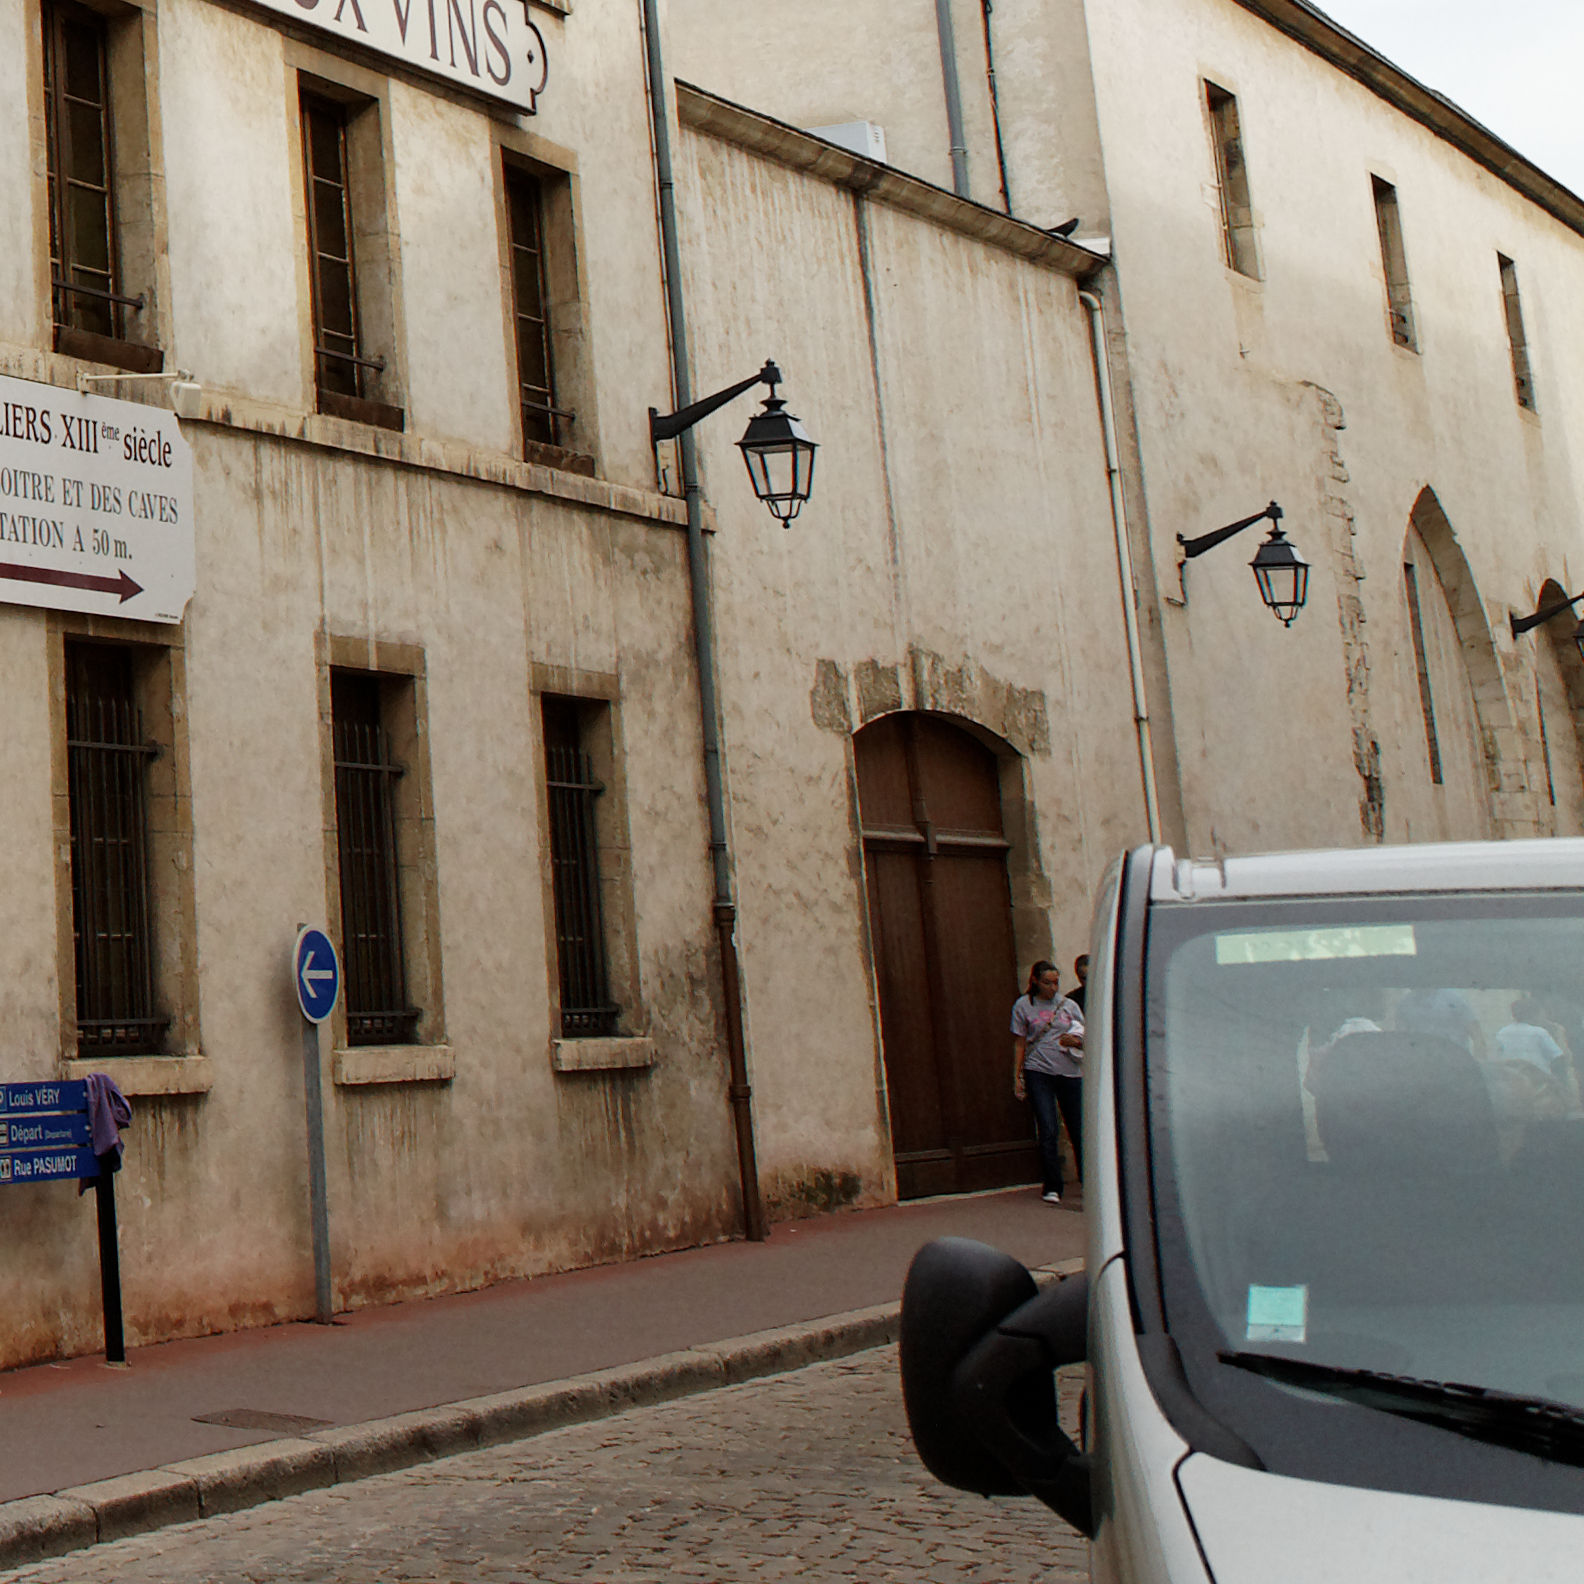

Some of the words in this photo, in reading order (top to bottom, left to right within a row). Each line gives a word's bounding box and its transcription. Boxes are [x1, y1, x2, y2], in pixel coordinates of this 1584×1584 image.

[123, 426, 173, 468] siècle
[61, 478, 84, 508] ET
[90, 483, 122, 516] DES
[128, 489, 179, 525] CAVES
[72, 524, 85, 552] A
[92, 528, 110, 556] 50
[113, 538, 133, 560] m.
[9, 1090, 35, 1107] Louis
[35, 1085, 61, 1106] VÉRY
[10, 1124, 43, 1144] Départ
[14, 1159, 32, 1176] Rue
[33, 1155, 77, 1175] PASUMOT
